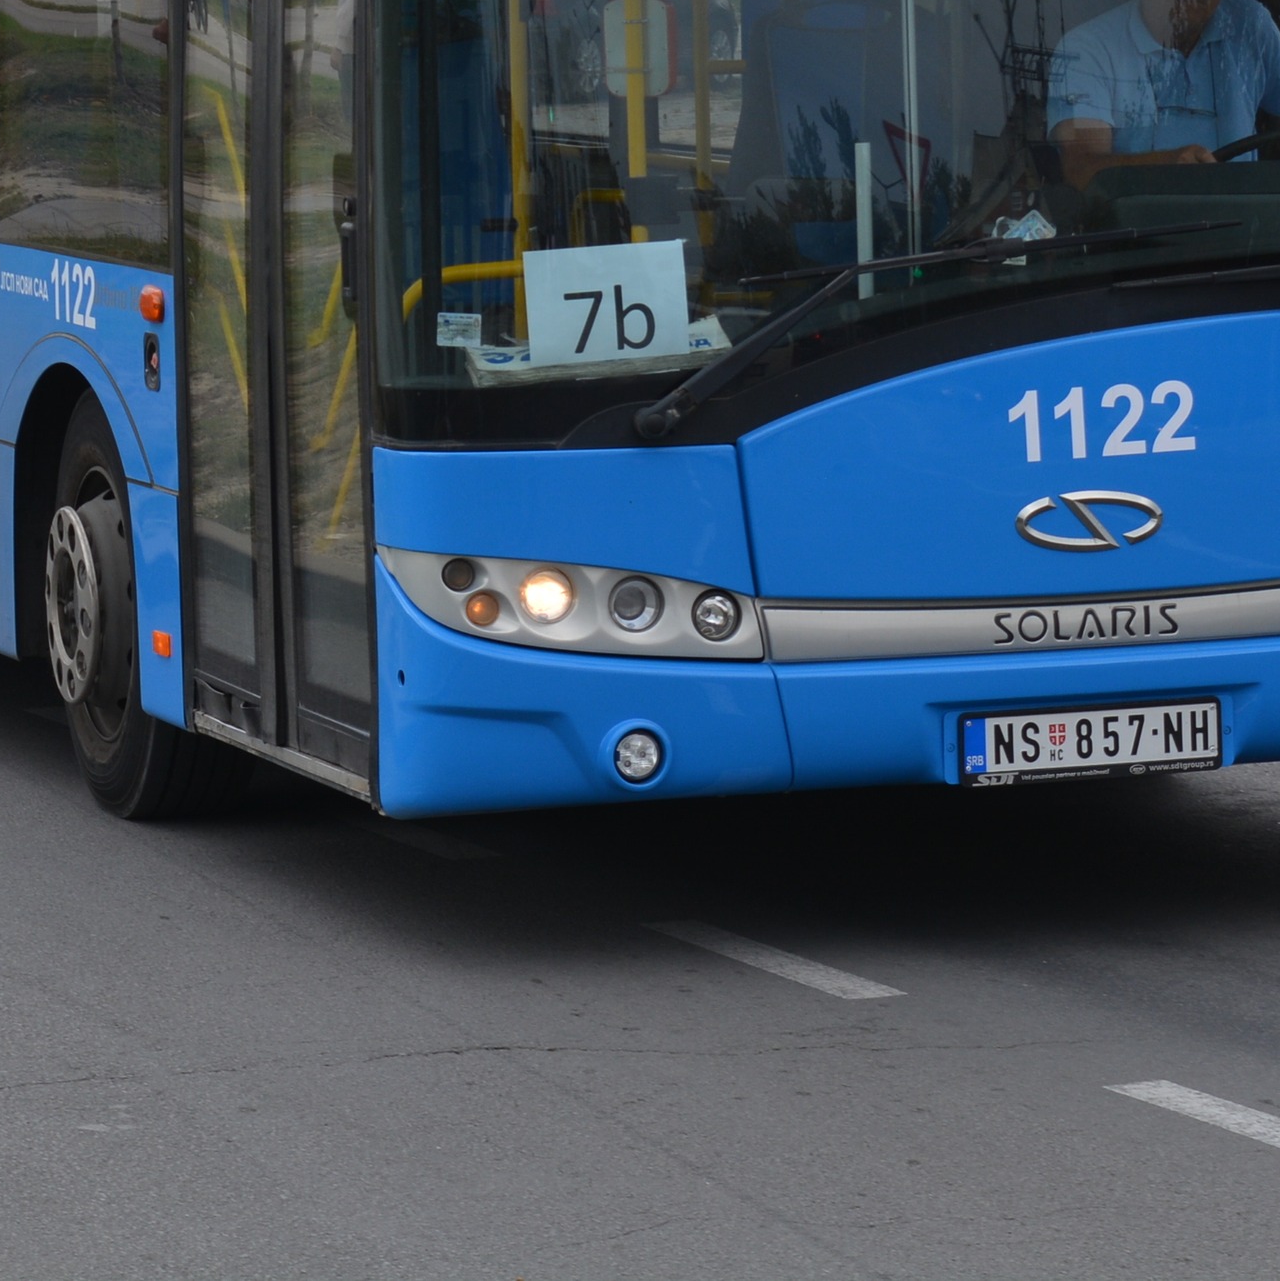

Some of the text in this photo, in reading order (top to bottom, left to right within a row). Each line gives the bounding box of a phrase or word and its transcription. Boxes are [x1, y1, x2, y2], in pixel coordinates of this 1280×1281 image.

[33, 278, 49, 302] САД
[51, 258, 97, 330] 1122
[563, 284, 656, 354] 7b
[1008, 379, 1197, 463] 1122
[994, 604, 1179, 645] SOLARIS
[966, 755, 984, 766] SRB
[993, 721, 1041, 766] NS
[971, 771, 1020, 787] SDT
[1148, 760, 1214, 772] www.sdtgroup.rs
